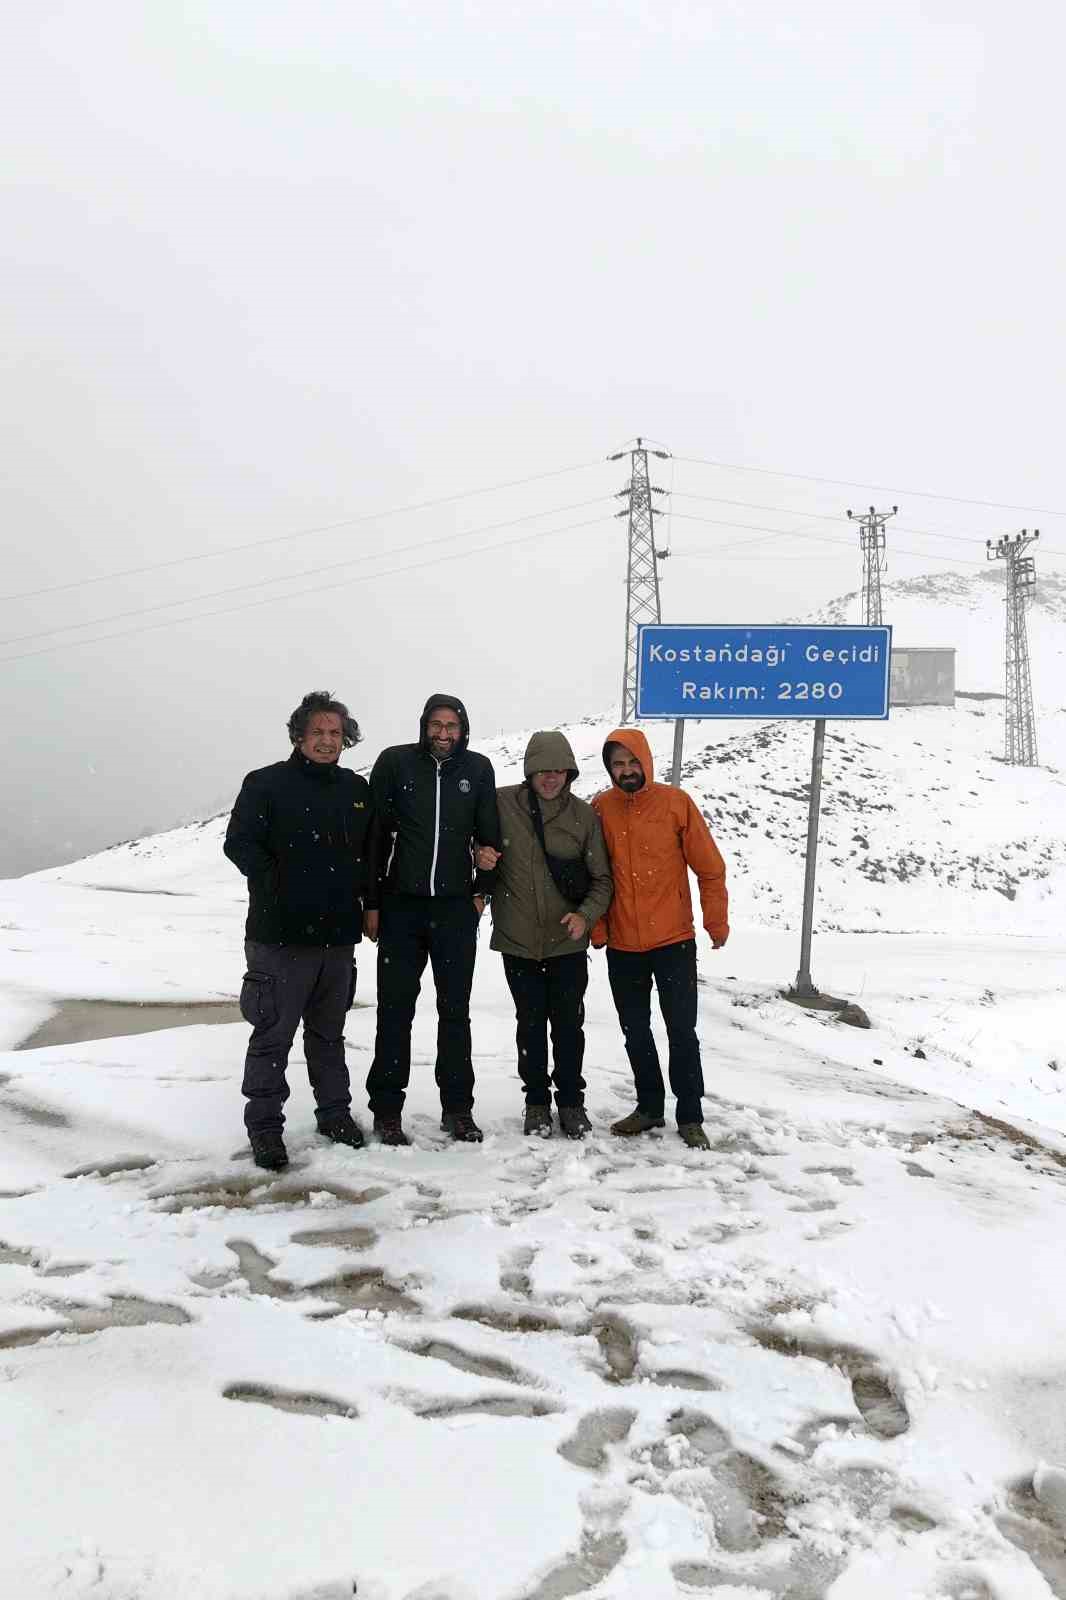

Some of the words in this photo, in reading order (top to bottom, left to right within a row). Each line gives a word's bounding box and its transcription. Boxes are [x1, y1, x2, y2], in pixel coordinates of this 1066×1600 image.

[805, 645, 880, 665] Geçidi
[682, 682, 766, 701] Rakım:
[777, 682, 844, 700] 2280
